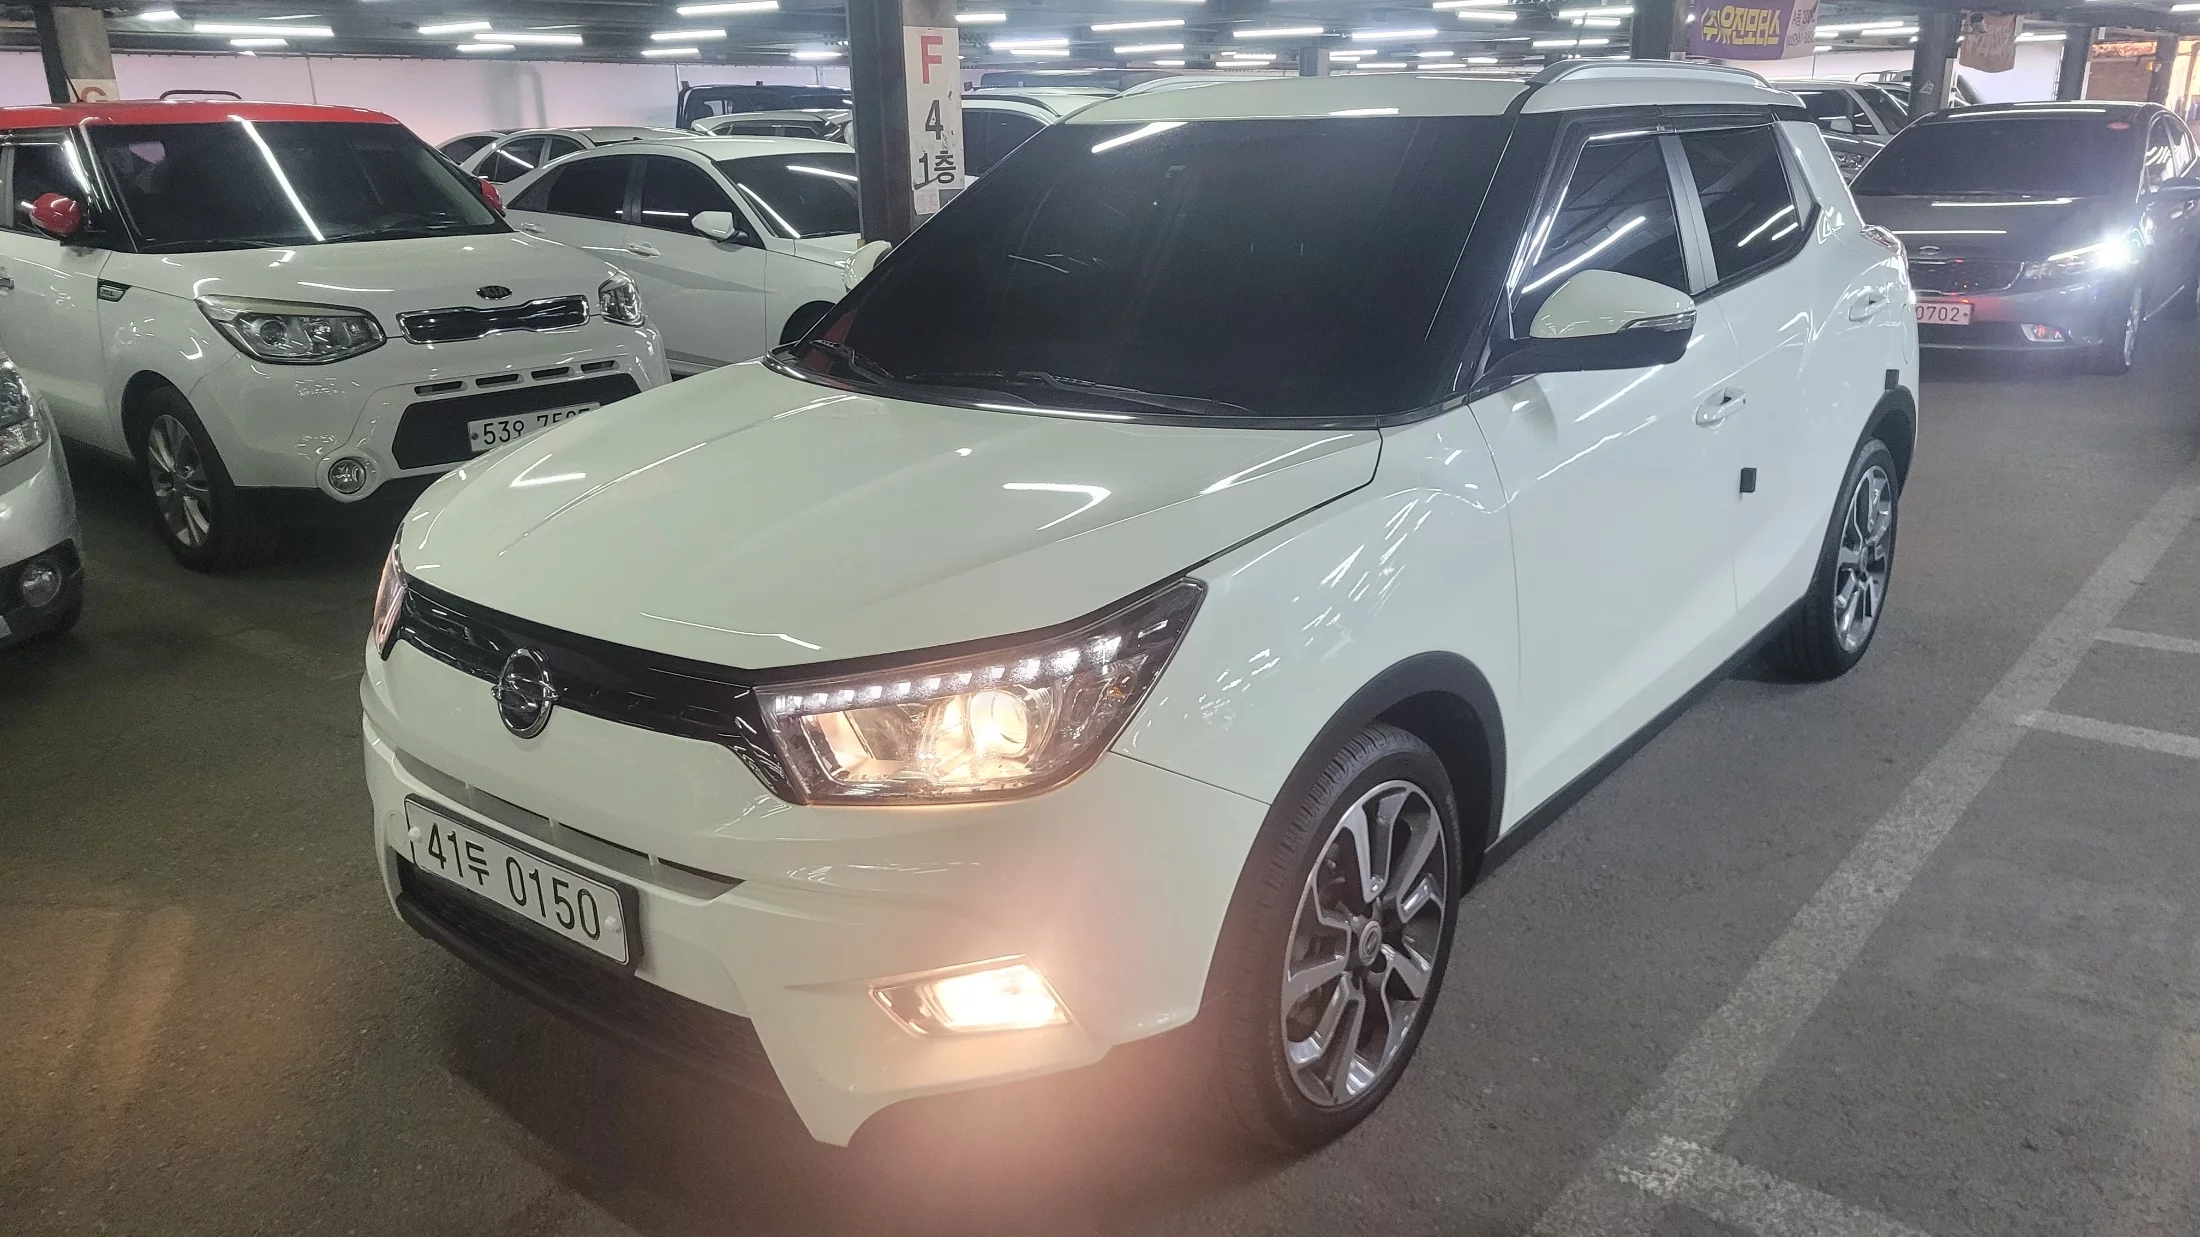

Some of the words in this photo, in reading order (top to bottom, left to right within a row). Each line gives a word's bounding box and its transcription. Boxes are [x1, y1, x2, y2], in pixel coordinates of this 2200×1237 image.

[1700, 5, 1781, 47] (주)유진모터스
[920, 35, 944, 84] F
[925, 99, 944, 140] 4
[914, 150, 957, 189] 1층
[1915, 305, 1960, 322] 0702
[427, 821, 490, 886] 41두
[505, 855, 600, 941] 0150
